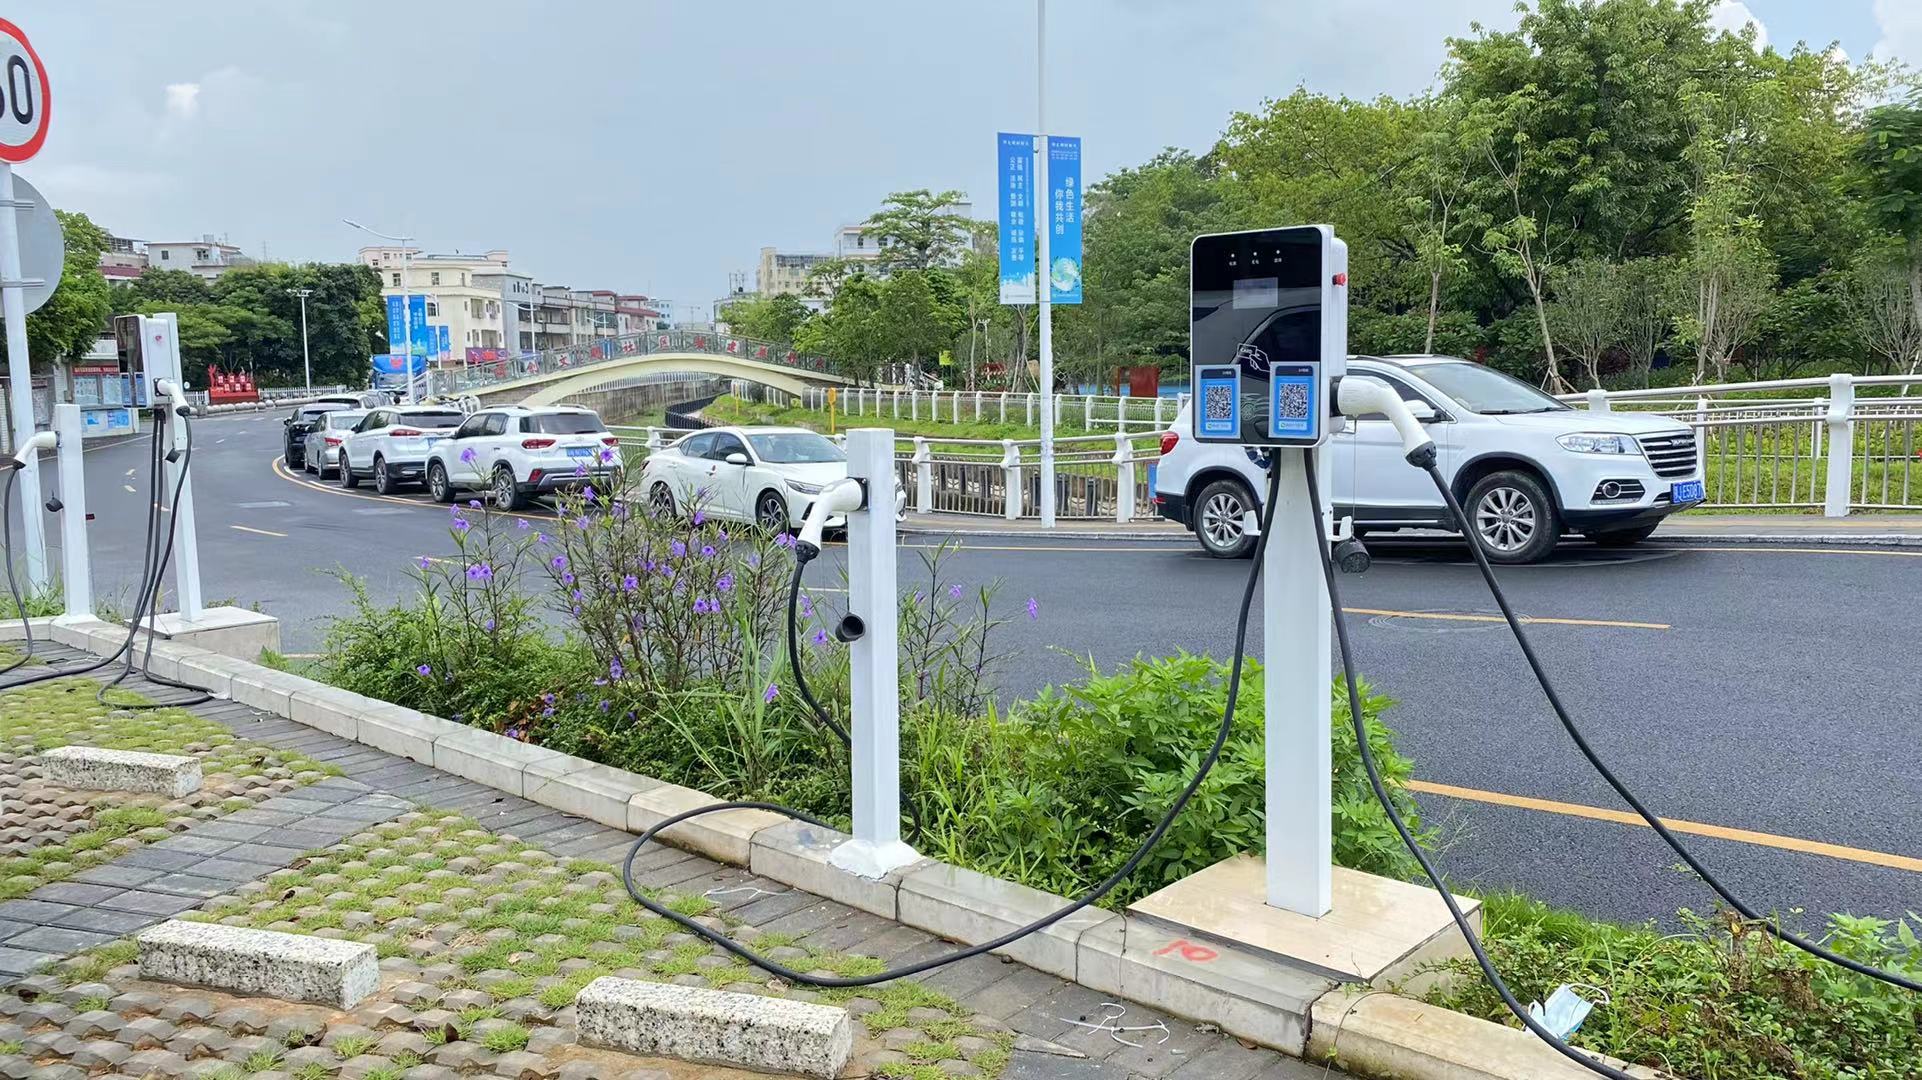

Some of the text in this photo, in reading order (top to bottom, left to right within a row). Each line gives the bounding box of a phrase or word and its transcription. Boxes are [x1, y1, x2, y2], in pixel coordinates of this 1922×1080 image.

[0, 55, 33, 125] 0
[1055, 188, 1064, 235] 你我共创
[1065, 177, 1075, 223] 绿色生活
